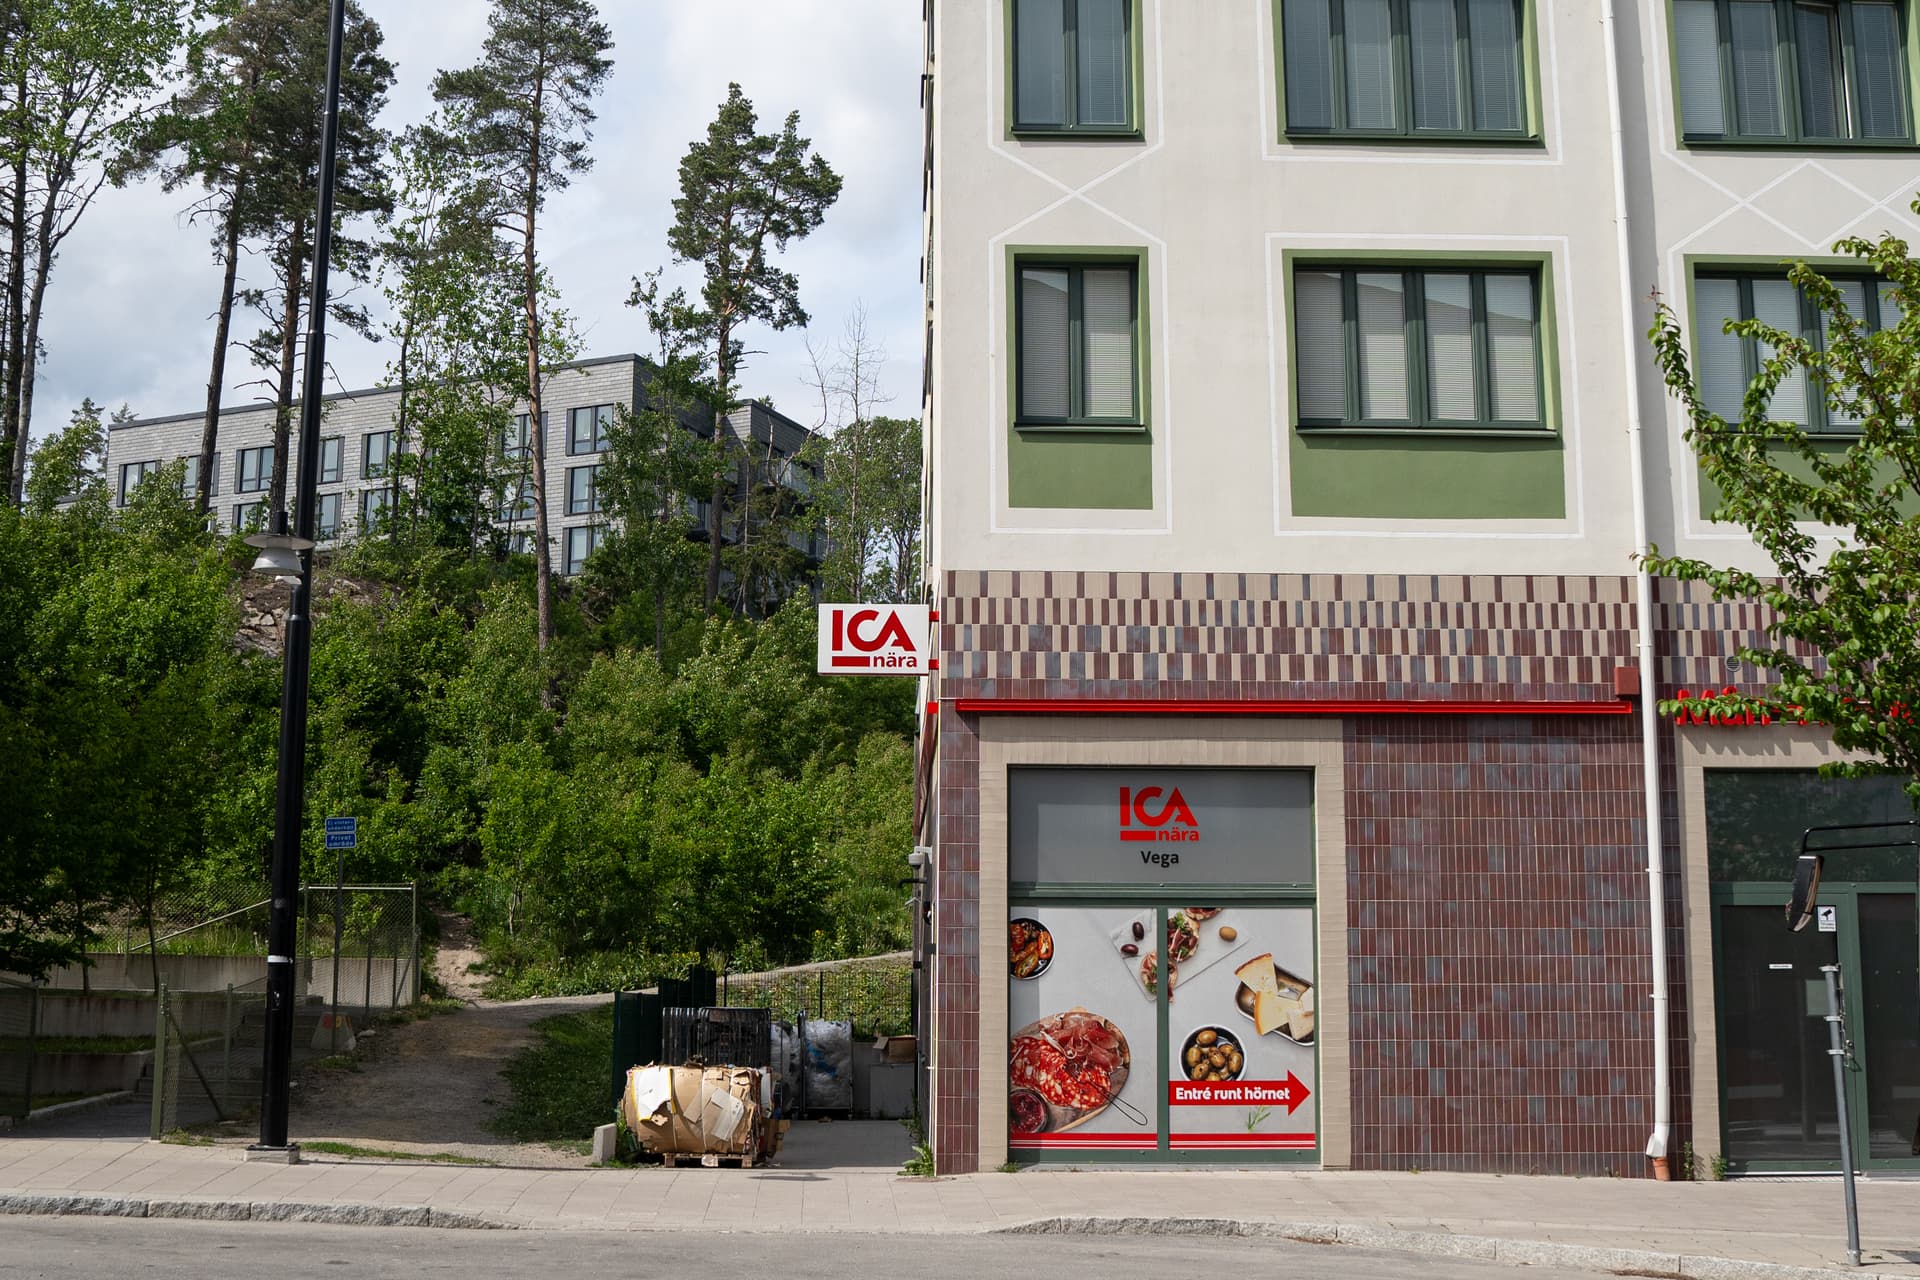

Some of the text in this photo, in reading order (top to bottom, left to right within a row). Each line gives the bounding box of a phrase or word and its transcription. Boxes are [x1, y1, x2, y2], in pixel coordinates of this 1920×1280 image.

[832, 609, 917, 652] ICA
[873, 652, 917, 667] nära
[1119, 785, 1199, 827] ICA
[1158, 826, 1200, 842] nära
[1140, 850, 1180, 869] Vega
[1175, 1086, 1291, 1101] Entré runt hörnet
